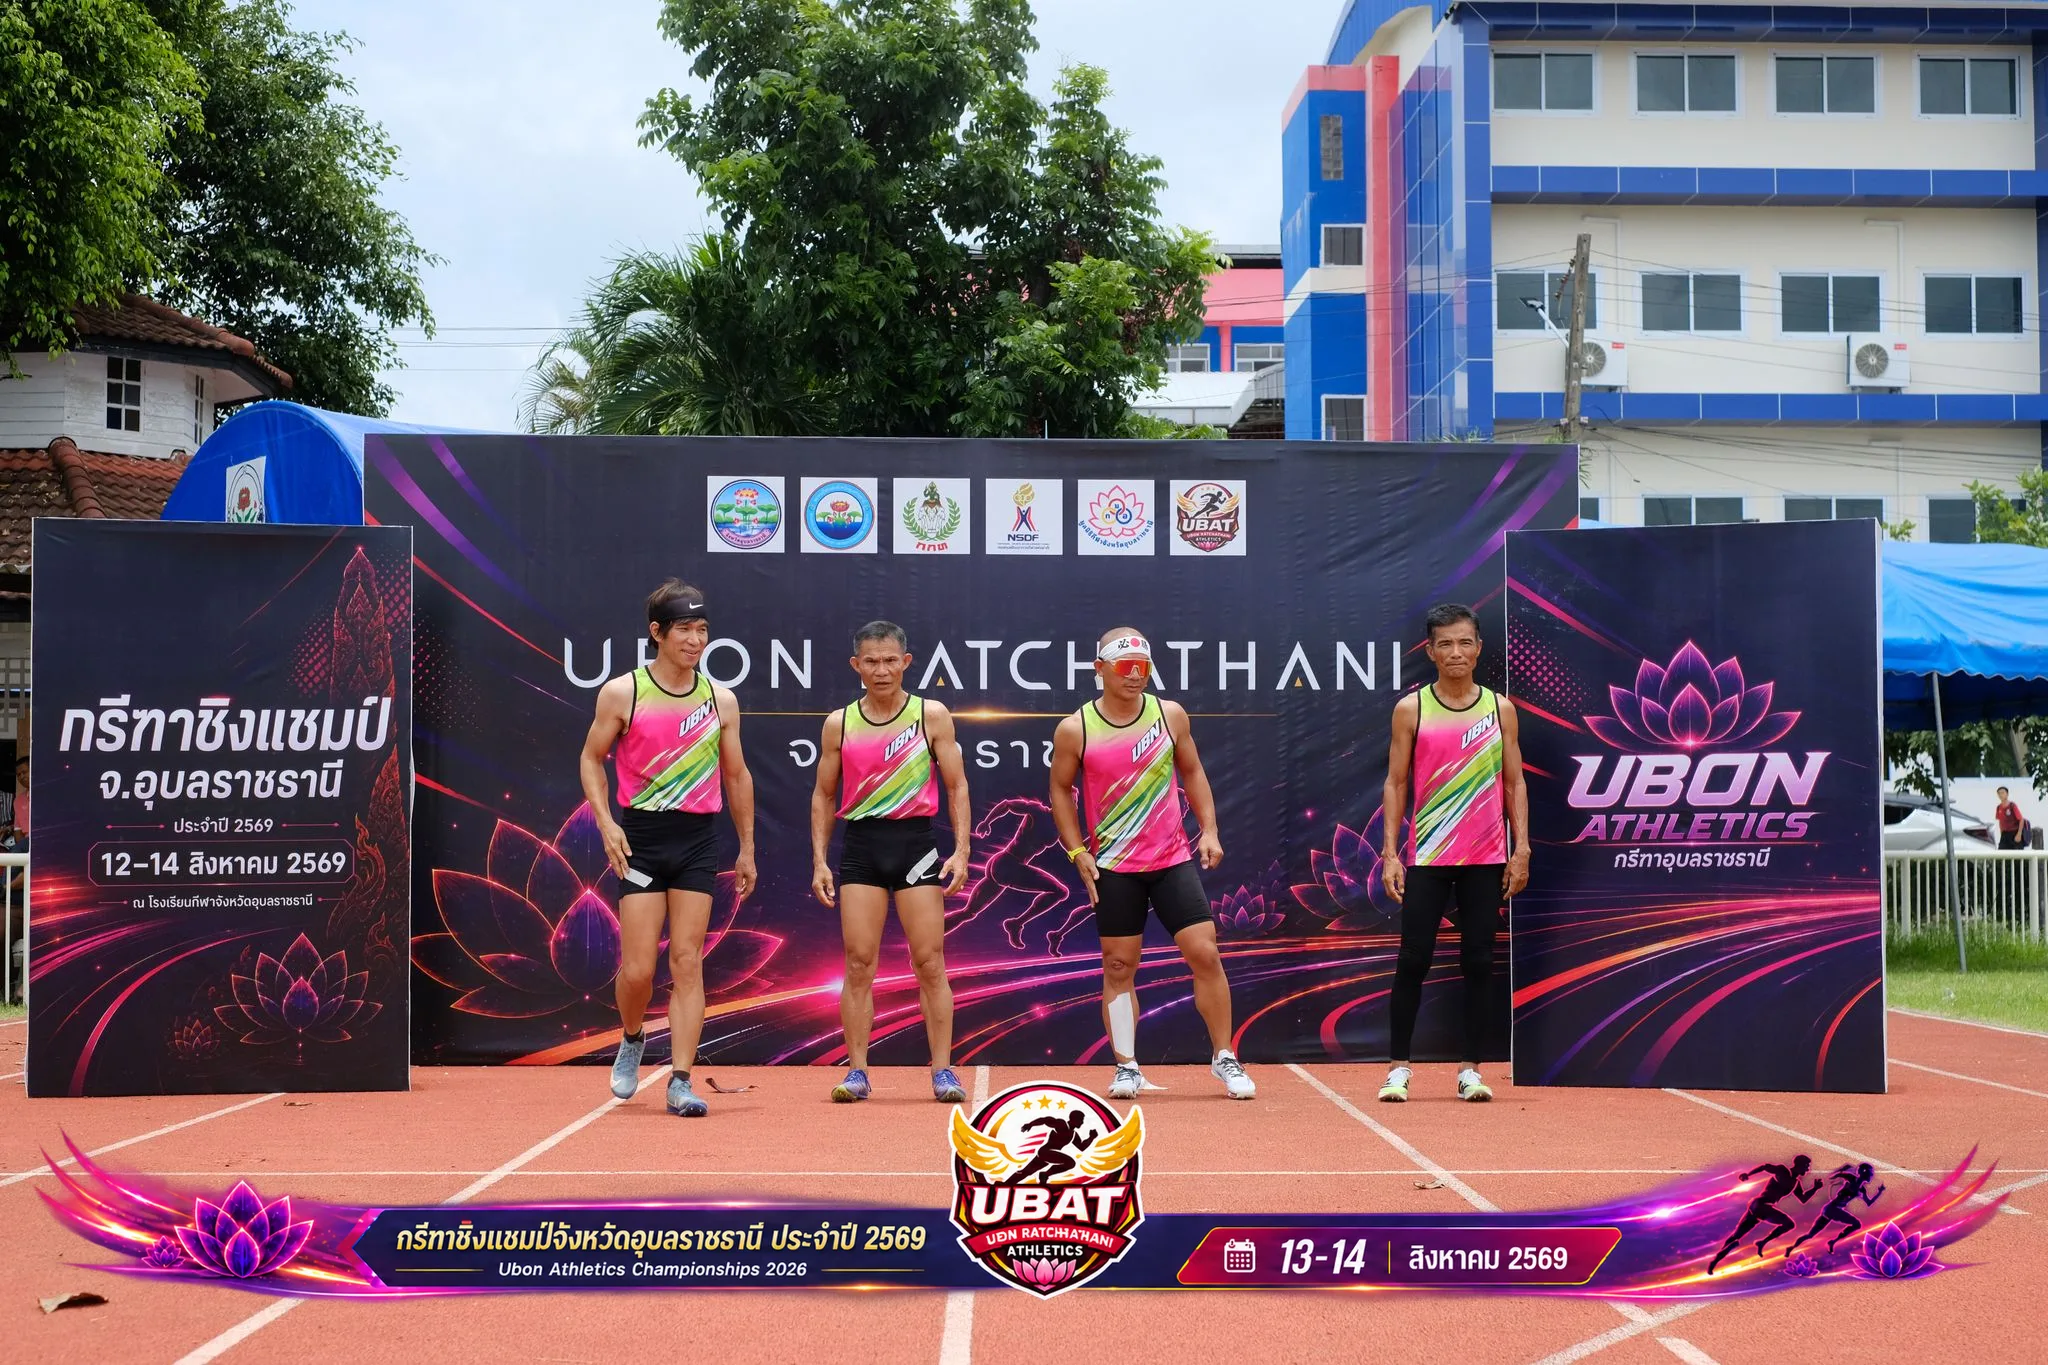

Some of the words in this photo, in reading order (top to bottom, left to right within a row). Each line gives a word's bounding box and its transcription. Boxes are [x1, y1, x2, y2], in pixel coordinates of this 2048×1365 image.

[1182, 518, 1235, 532] UBAT
[861, 639, 1401, 691] ATCHTHANI
[59, 694, 392, 752] กรีฑาชิงแชมป์
[679, 699, 711, 737] UBN
[1460, 711, 1493, 750] UBN
[884, 721, 918, 762] UBN
[1131, 719, 1160, 763] UBN
[99, 758, 344, 811] จ.อุบลราชธานี
[1567, 751, 1832, 808] UBON
[174, 816, 229, 833] ประจำปี
[234, 818, 274, 833] 2569
[1570, 811, 1822, 843] ATHLETICS
[189, 851, 278, 875] สิงหาคม
[287, 851, 346, 874] 2569
[1614, 847, 1771, 873] กรีฑาอุบลราชธานี
[132, 900, 145, 909] ณ
